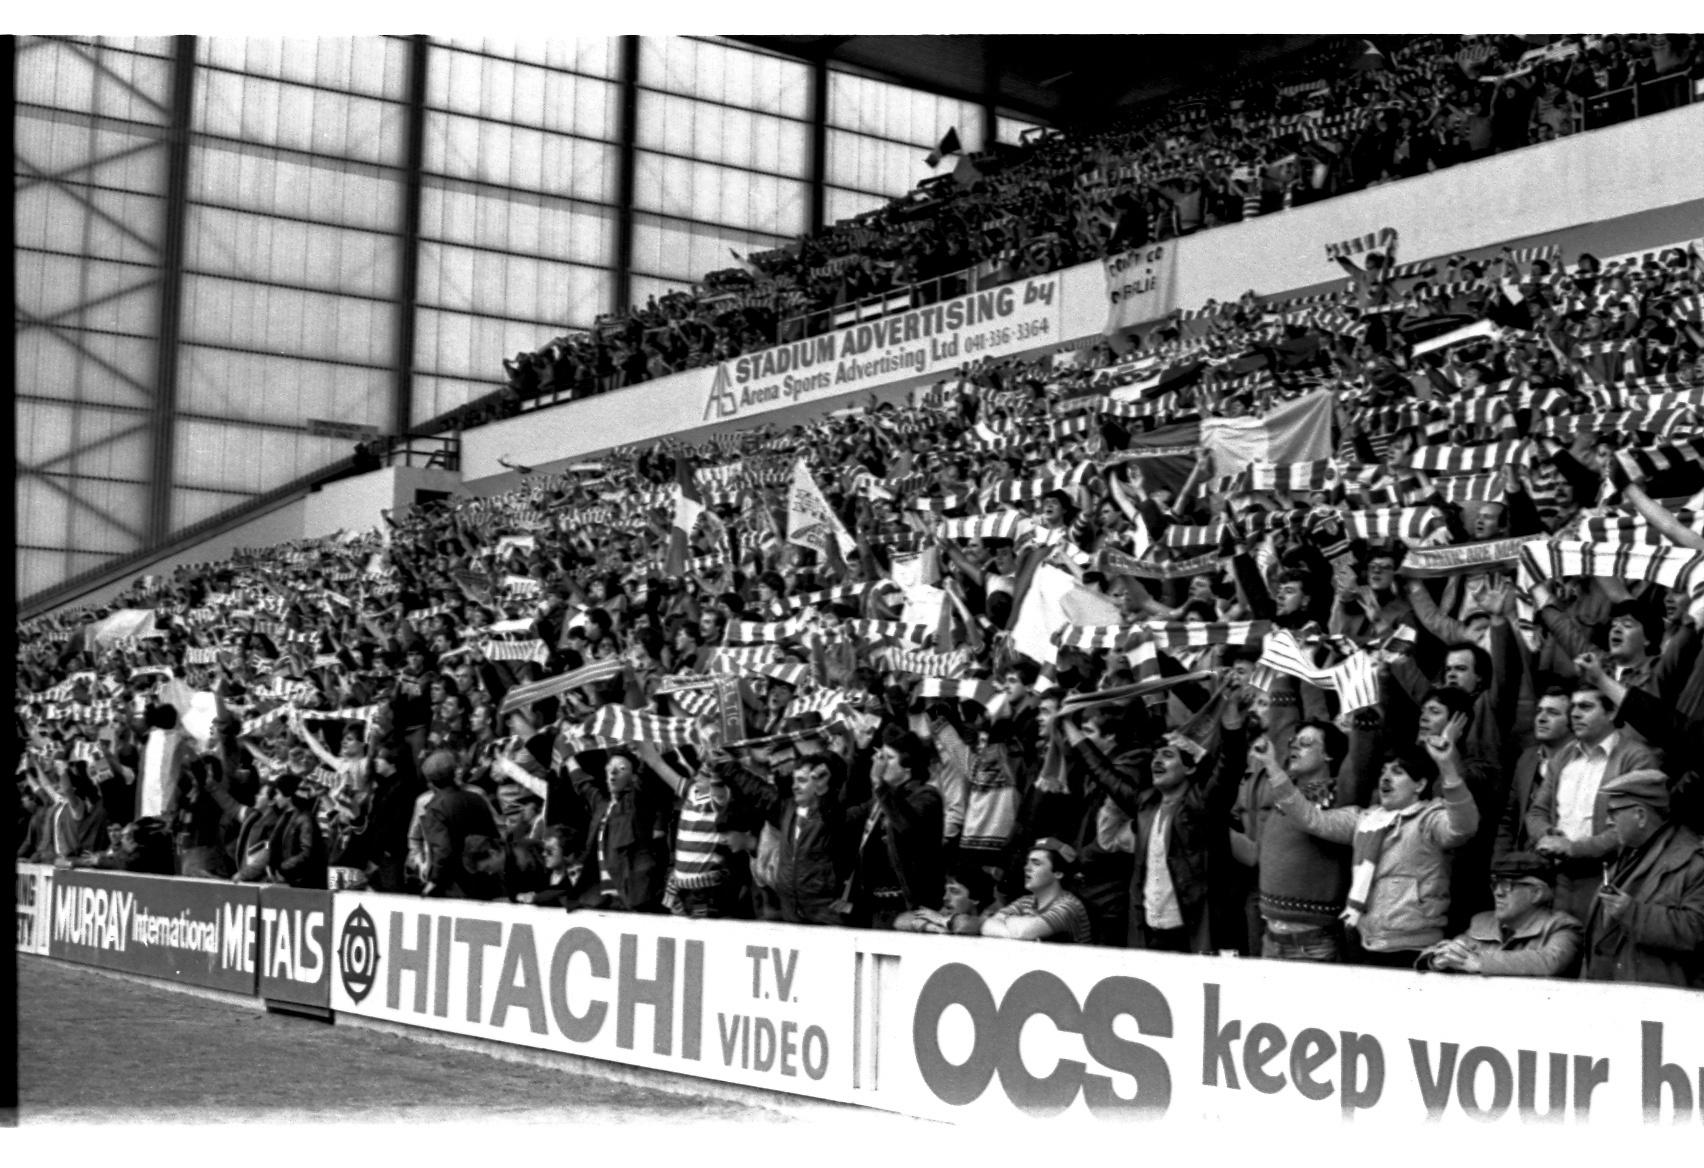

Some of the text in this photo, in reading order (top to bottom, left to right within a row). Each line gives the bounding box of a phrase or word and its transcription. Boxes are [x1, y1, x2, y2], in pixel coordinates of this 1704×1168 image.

[736, 281, 1054, 384] STADIUM ADVERTISING by
[741, 385, 780, 407] Arena
[783, 372, 831, 402] Sports
[835, 347, 925, 385] Advertising
[932, 332, 958, 361] Ltd
[55, 884, 133, 951] MURRAY
[132, 899, 220, 953] International
[222, 901, 324, 984] METALS
[746, 945, 799, 1002] T.V.
[386, 910, 705, 1061] HITACHI
[717, 1012, 829, 1081] VIDEO
[913, 962, 1174, 1122] OCS
[1202, 983, 1385, 1123] keep
[1641, 1020, 1704, 1127] h
